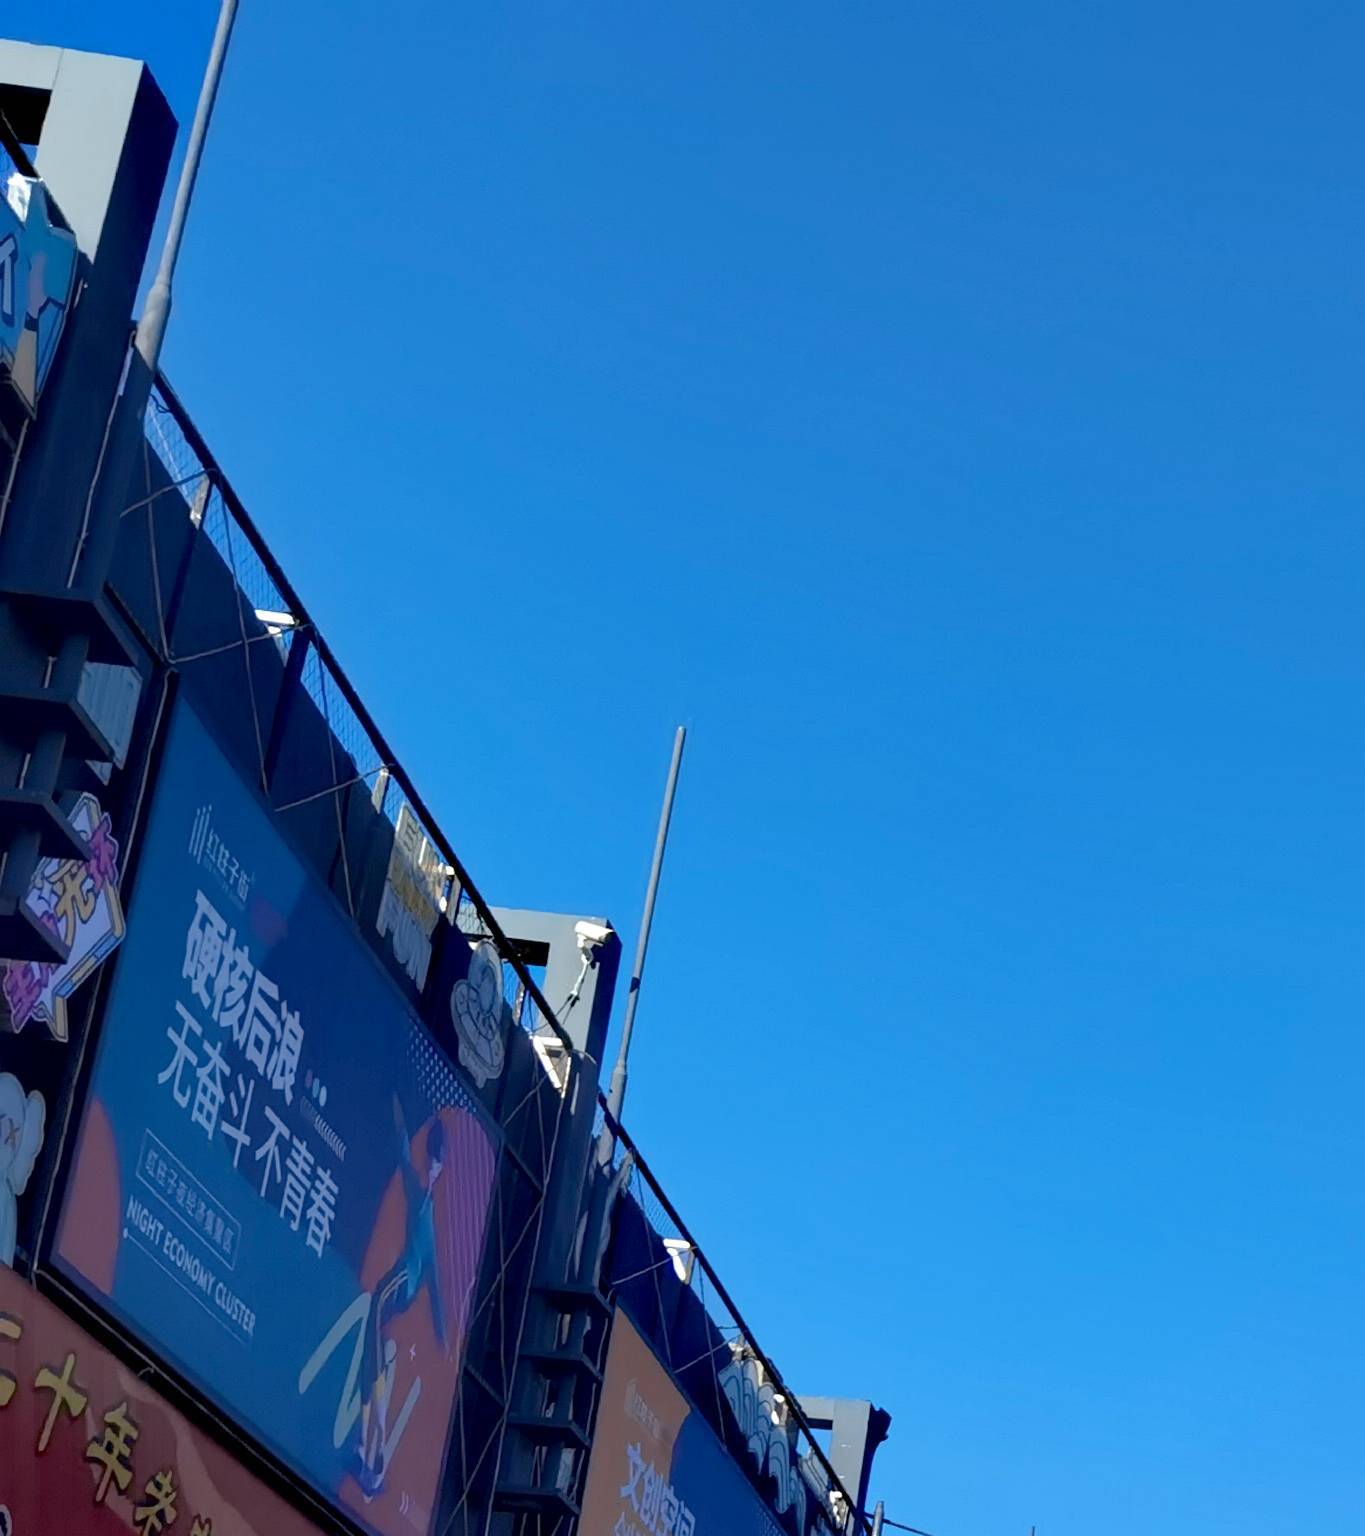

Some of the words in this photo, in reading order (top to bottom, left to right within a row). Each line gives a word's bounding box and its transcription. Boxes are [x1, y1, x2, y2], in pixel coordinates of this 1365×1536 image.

[181, 888, 305, 1106] 硬核后浪
[157, 1000, 340, 1259] 无奋斗不青春
[126, 1194, 165, 1246] NIGHT
[162, 1231, 217, 1298] ECONOMY
[214, 1281, 257, 1337] CLUSTER
